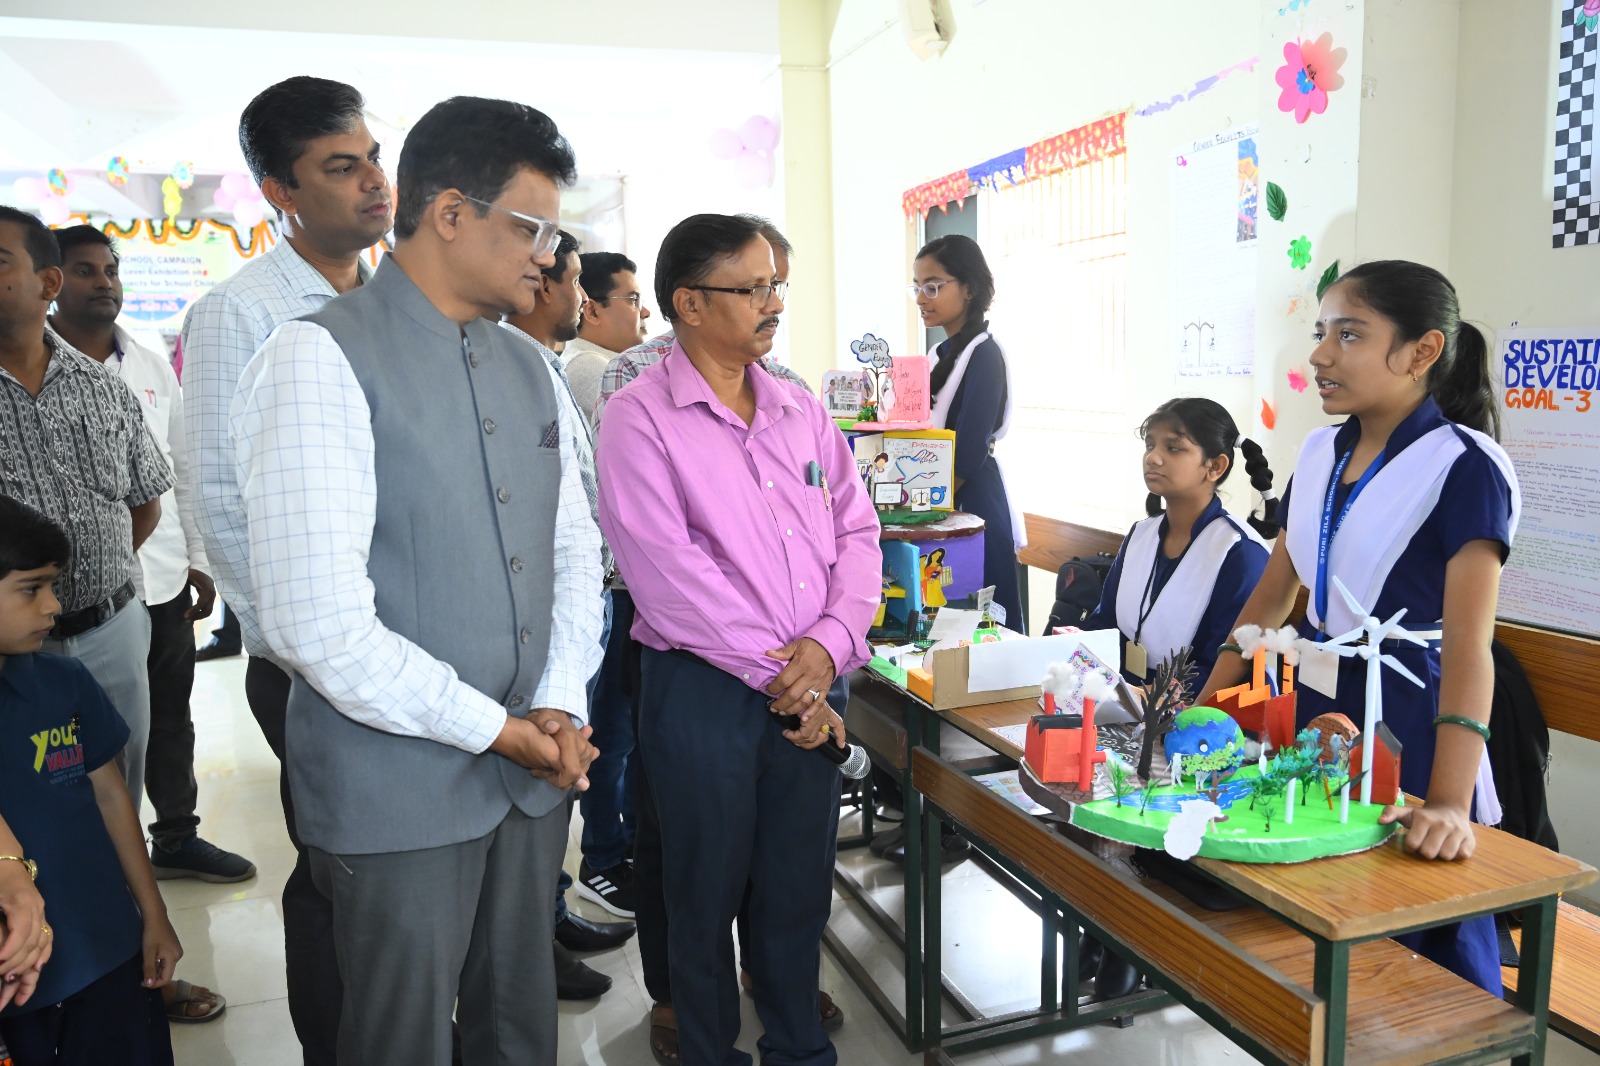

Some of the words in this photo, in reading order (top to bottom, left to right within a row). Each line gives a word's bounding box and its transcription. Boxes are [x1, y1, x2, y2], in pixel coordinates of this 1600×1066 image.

[157, 256, 202, 264] CAMPAIGN
[148, 267, 190, 276] Exhibition
[1505, 364, 1600, 391] DEVELO
[1505, 388, 1560, 411] GOAL
[1322, 515, 1330, 534] ZILA
